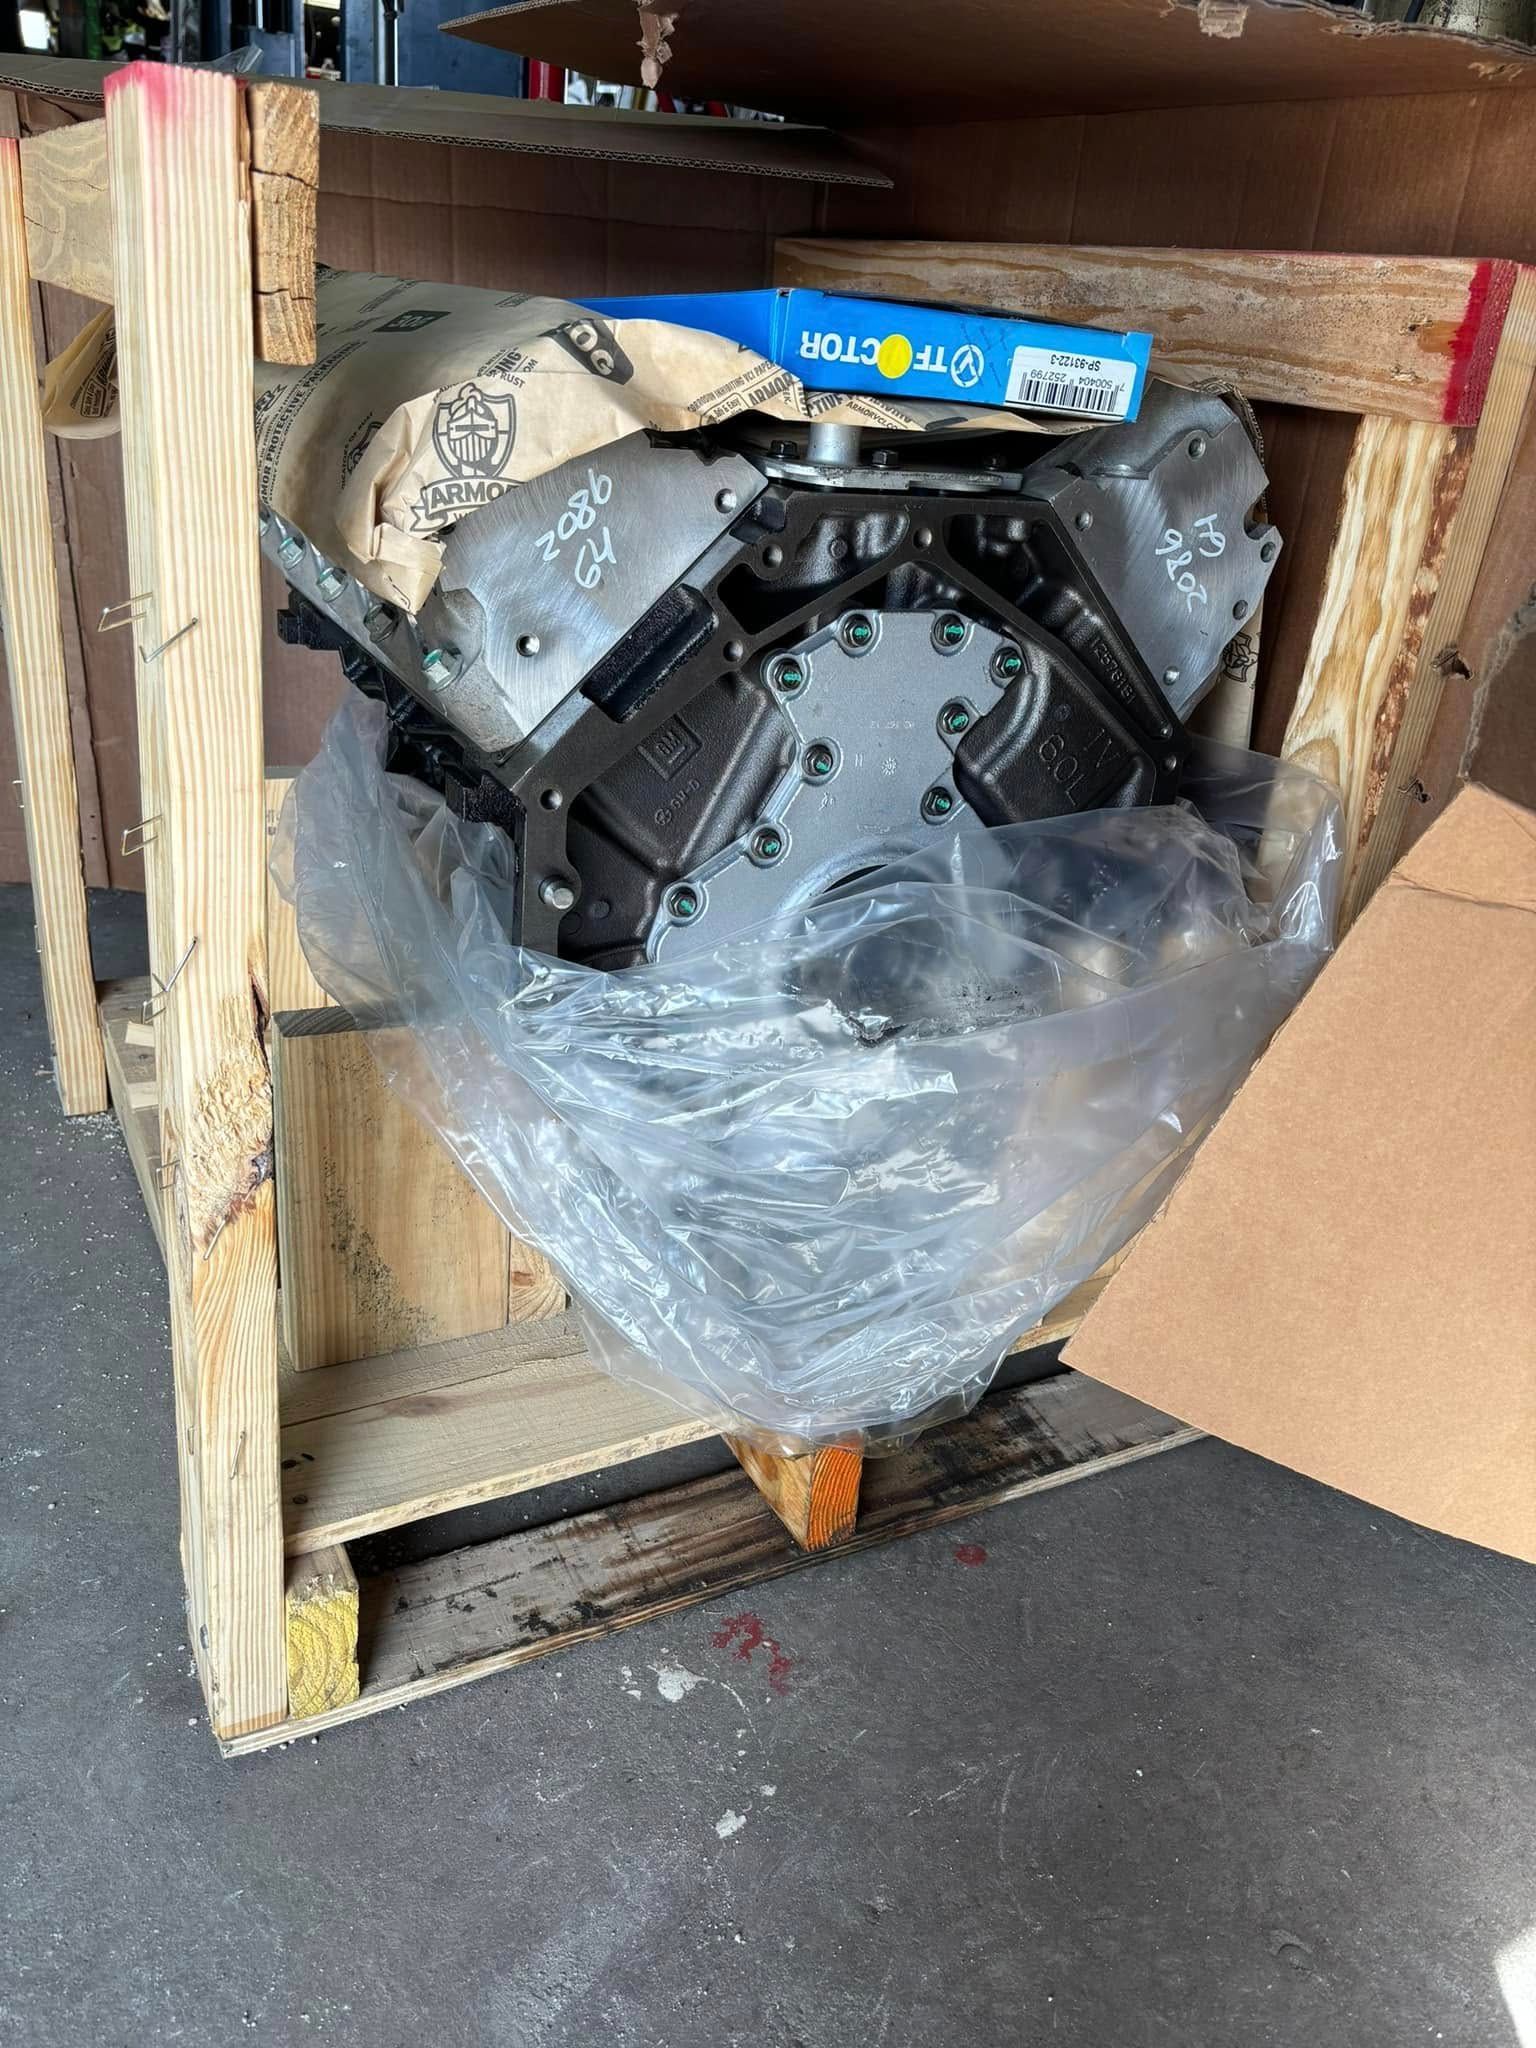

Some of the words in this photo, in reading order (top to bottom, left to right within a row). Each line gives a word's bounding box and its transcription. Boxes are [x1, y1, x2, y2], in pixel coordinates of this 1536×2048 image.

[1030, 369, 1067, 383] 252799
[1051, 354, 1101, 372] SP-93122-3
[266, 391, 305, 462] PROTECTIVE
[535, 468, 612, 561] 2086
[574, 526, 617, 589] 64
[1039, 734, 1085, 807] 6.0L
